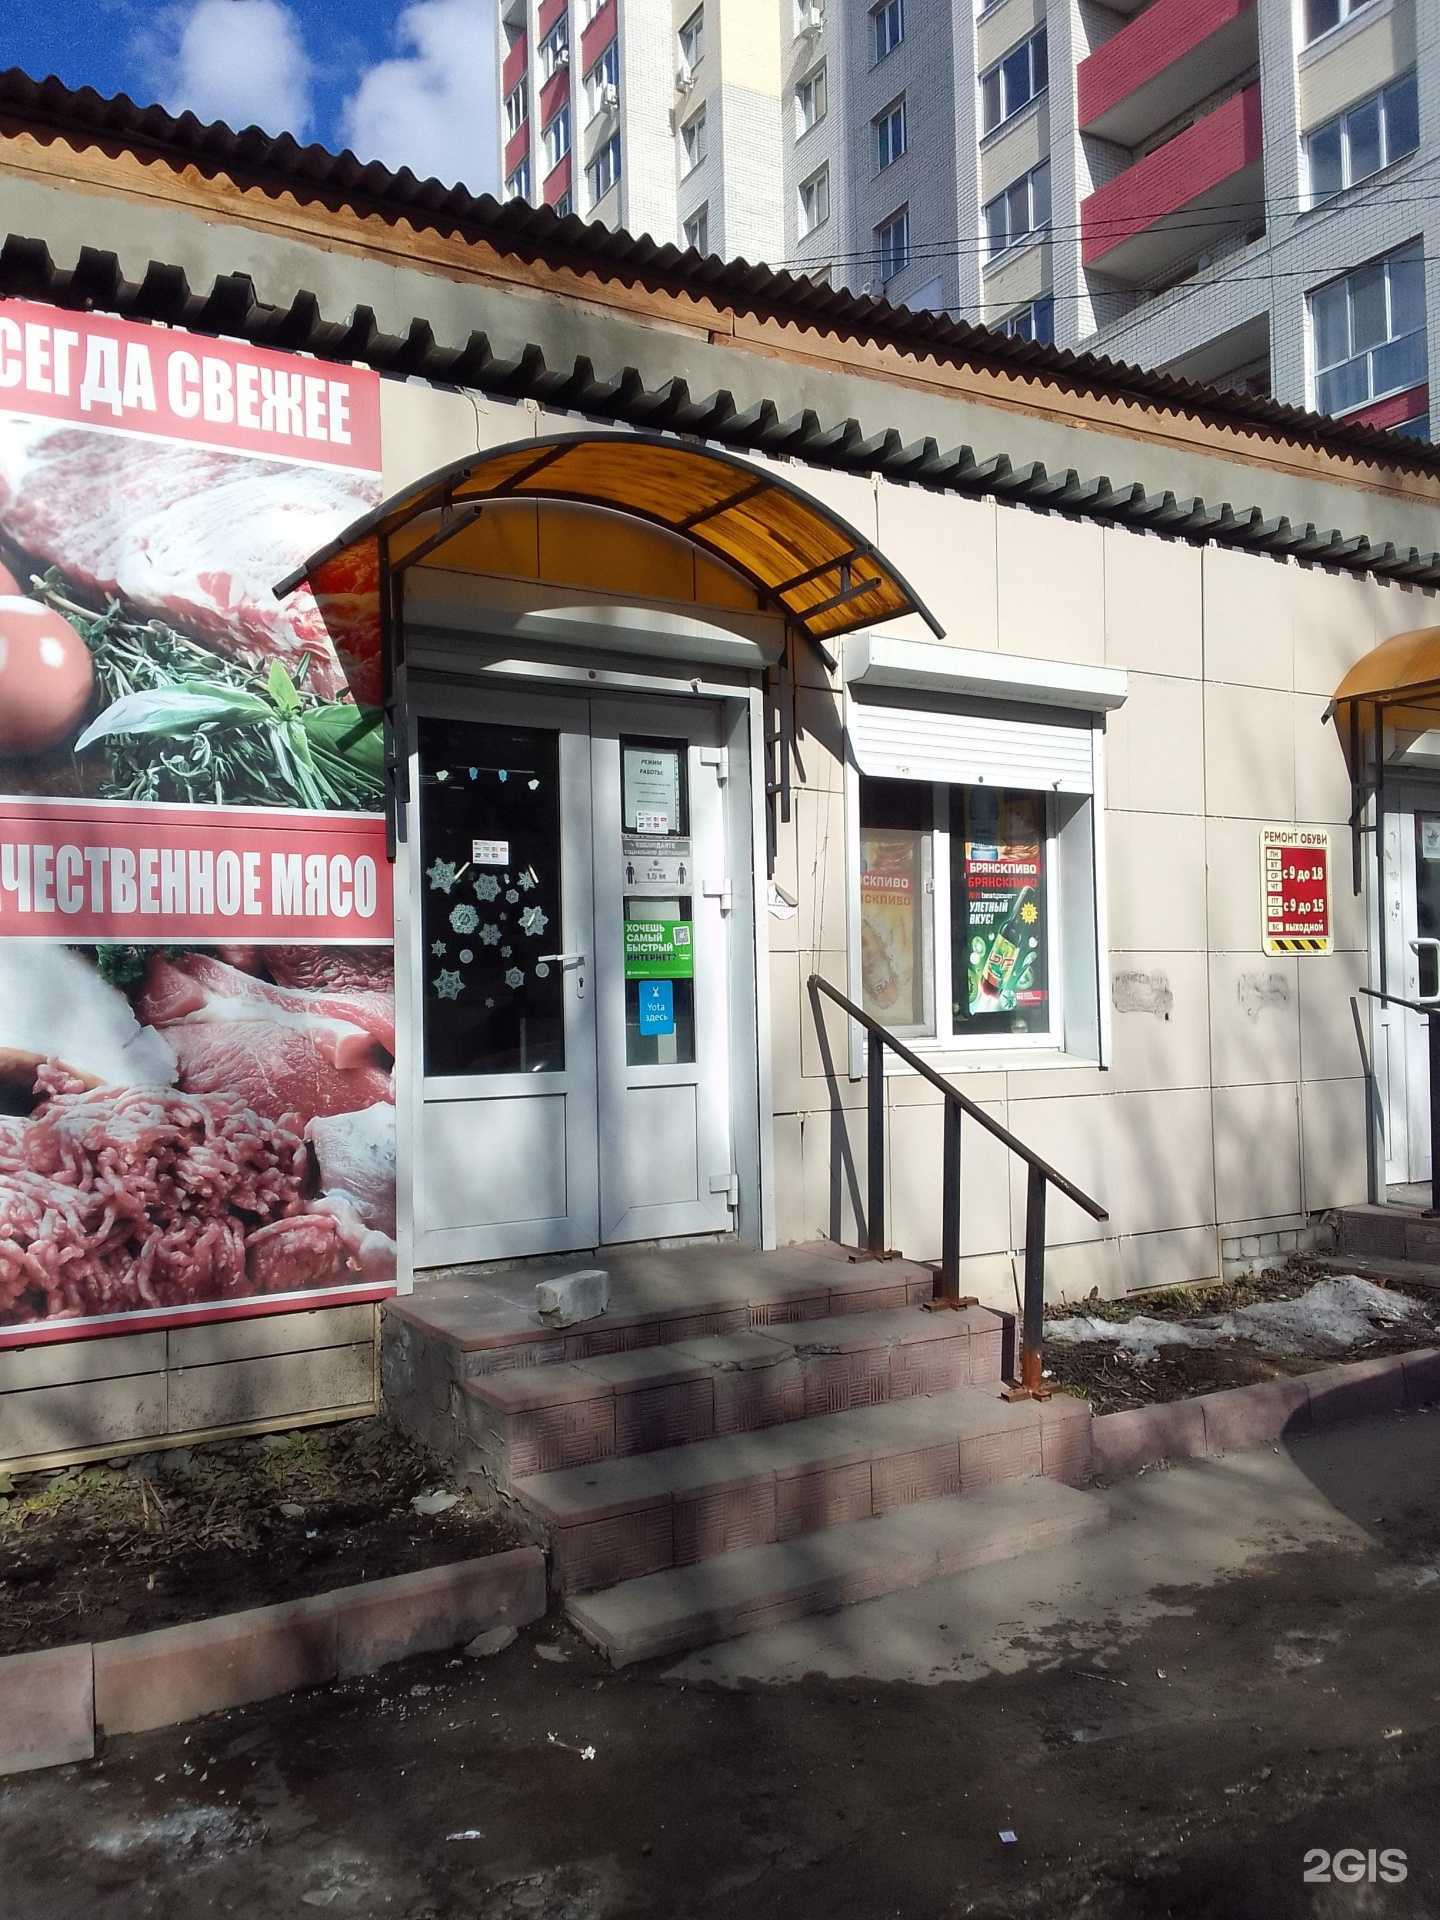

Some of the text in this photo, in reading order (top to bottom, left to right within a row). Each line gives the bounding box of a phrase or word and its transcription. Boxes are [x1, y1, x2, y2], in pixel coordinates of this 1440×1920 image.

[166, 350, 352, 445] СВЕЖЕЕ
[1264, 831, 1328, 845] РЕМОНТ ОБУВИ
[969, 862, 1037, 874] БРЯНСКПИВО
[1283, 866, 1324, 883] с 9 до 18
[271, 853, 377, 918] МЯСО
[968, 876, 1038, 888] БРЯНСКПИВО
[969, 899, 1009, 912] УЛЕТНЫЙ
[1283, 898, 1324, 915] с 9 до 15
[969, 913, 994, 925] ВКУС!
[626, 923, 665, 932] ХОЧЕШЬ
[1285, 919, 1324, 934] выходной
[626, 932, 663, 942] САМЫЙ
[626, 942, 673, 952] БЫСТРЫЙ
[647, 1002, 665, 1011] Yota
[645, 1014, 669, 1022] здесь
